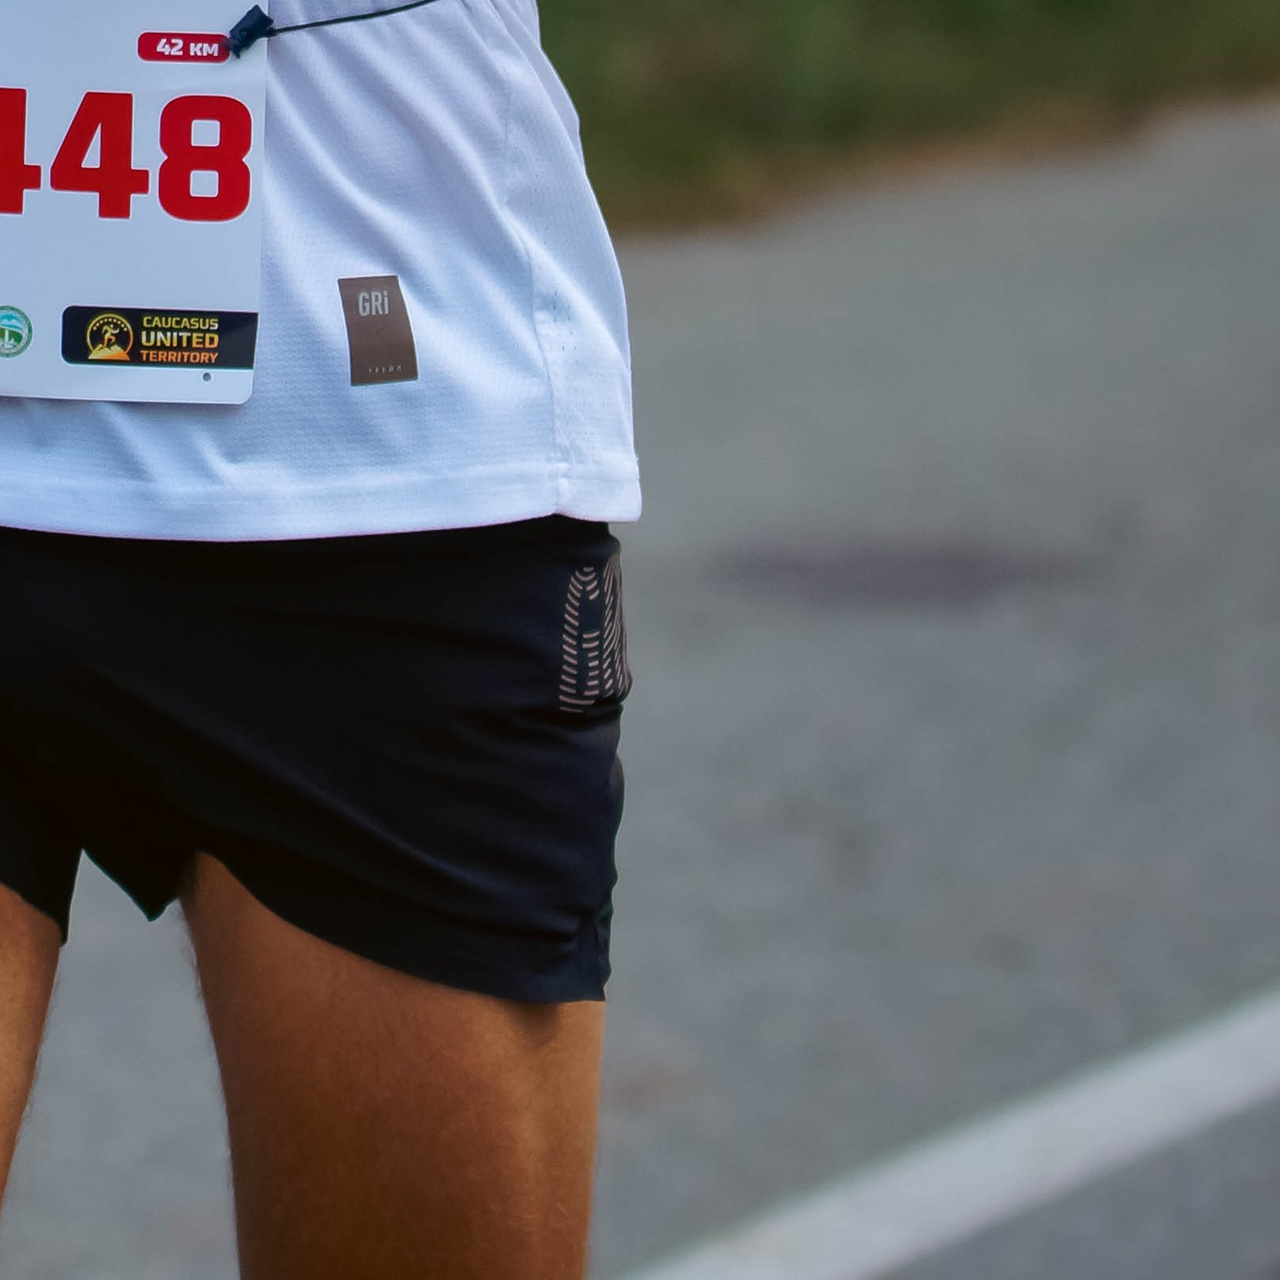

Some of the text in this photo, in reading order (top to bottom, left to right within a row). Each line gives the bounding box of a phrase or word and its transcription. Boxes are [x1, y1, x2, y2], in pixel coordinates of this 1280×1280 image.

[156, 38, 184, 56] 42
[142, 315, 220, 330] CAUCASUS
[141, 330, 220, 349] UNITED
[139, 349, 219, 364] TERRITORY
